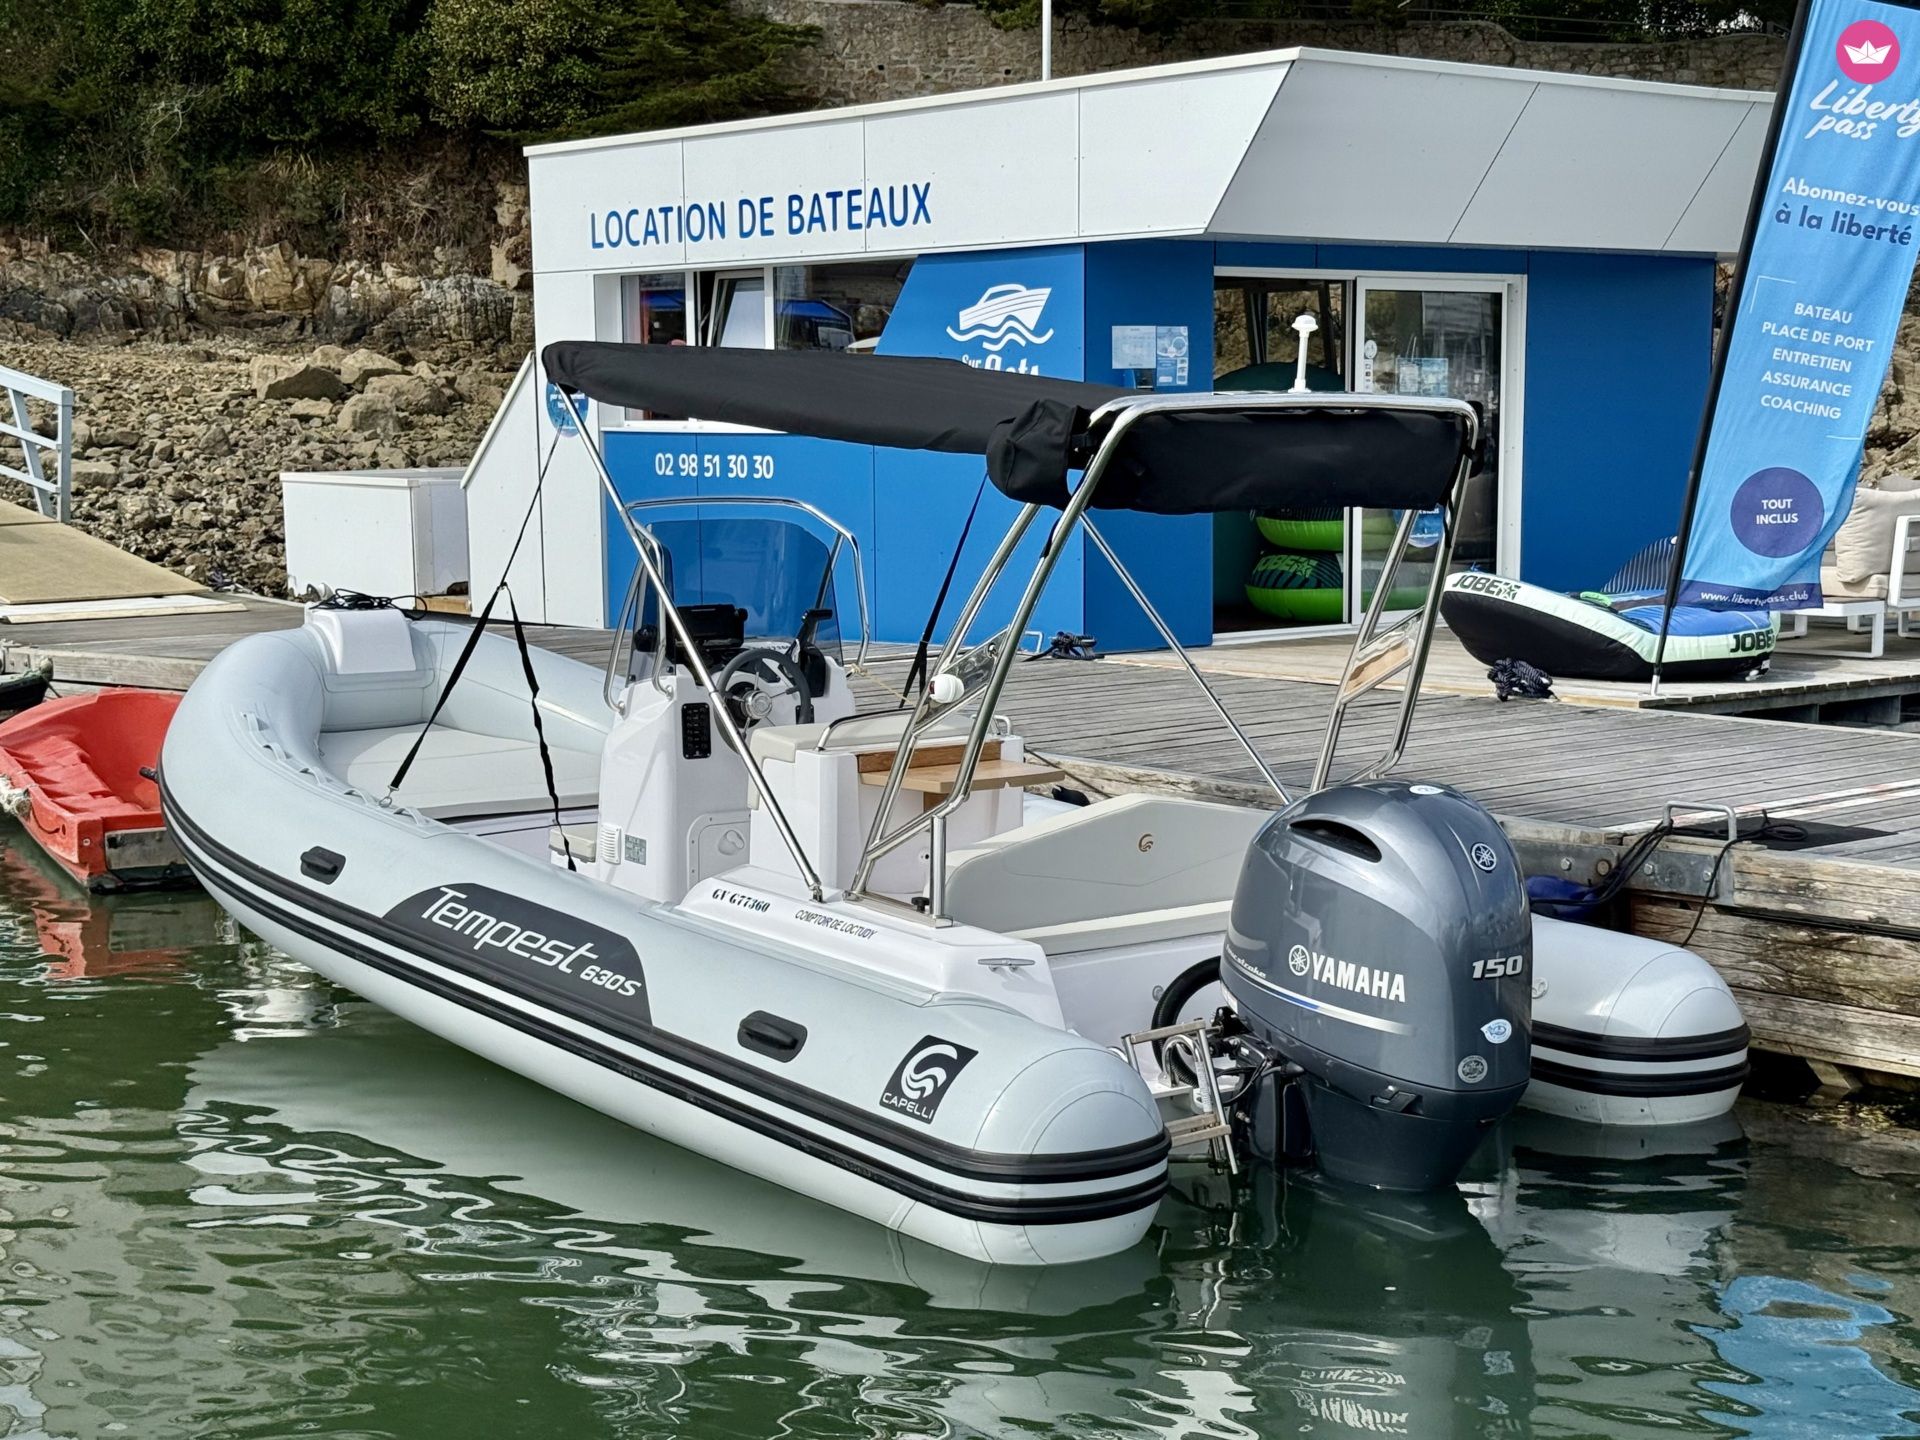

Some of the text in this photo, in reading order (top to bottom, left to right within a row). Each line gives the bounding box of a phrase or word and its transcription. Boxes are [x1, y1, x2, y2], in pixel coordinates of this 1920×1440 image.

[1810, 79, 1920, 138] Liberty
[1804, 115, 1878, 140] pass
[1782, 176, 1920, 216] Abonnez-vous
[591, 182, 932, 249] LOCATION DE BATEAUX
[1775, 202, 1913, 246] à la liberté
[1794, 302, 1853, 325] BATEAU
[1761, 321, 1875, 353] PLACE DE PORT
[1772, 347, 1852, 373] ENTRETIEN
[1761, 370, 1852, 397] ASSURANCE
[1760, 395, 1842, 420] COACHING
[655, 452, 774, 479] 02 98 51 30 30
[1761, 498, 1793, 510] TOUT
[1755, 512, 1799, 525] INCLUS
[1452, 574, 1503, 595] JOBE
[1730, 628, 1775, 653] JOBE
[795, 909, 878, 940] COMPTOIR DE LOCTUDY
[421, 886, 642, 997] Tempest 630S
[1312, 951, 1406, 1003] YAMAHA
[1471, 954, 1523, 980] 150
[882, 1092, 935, 1120] CAPELLI
